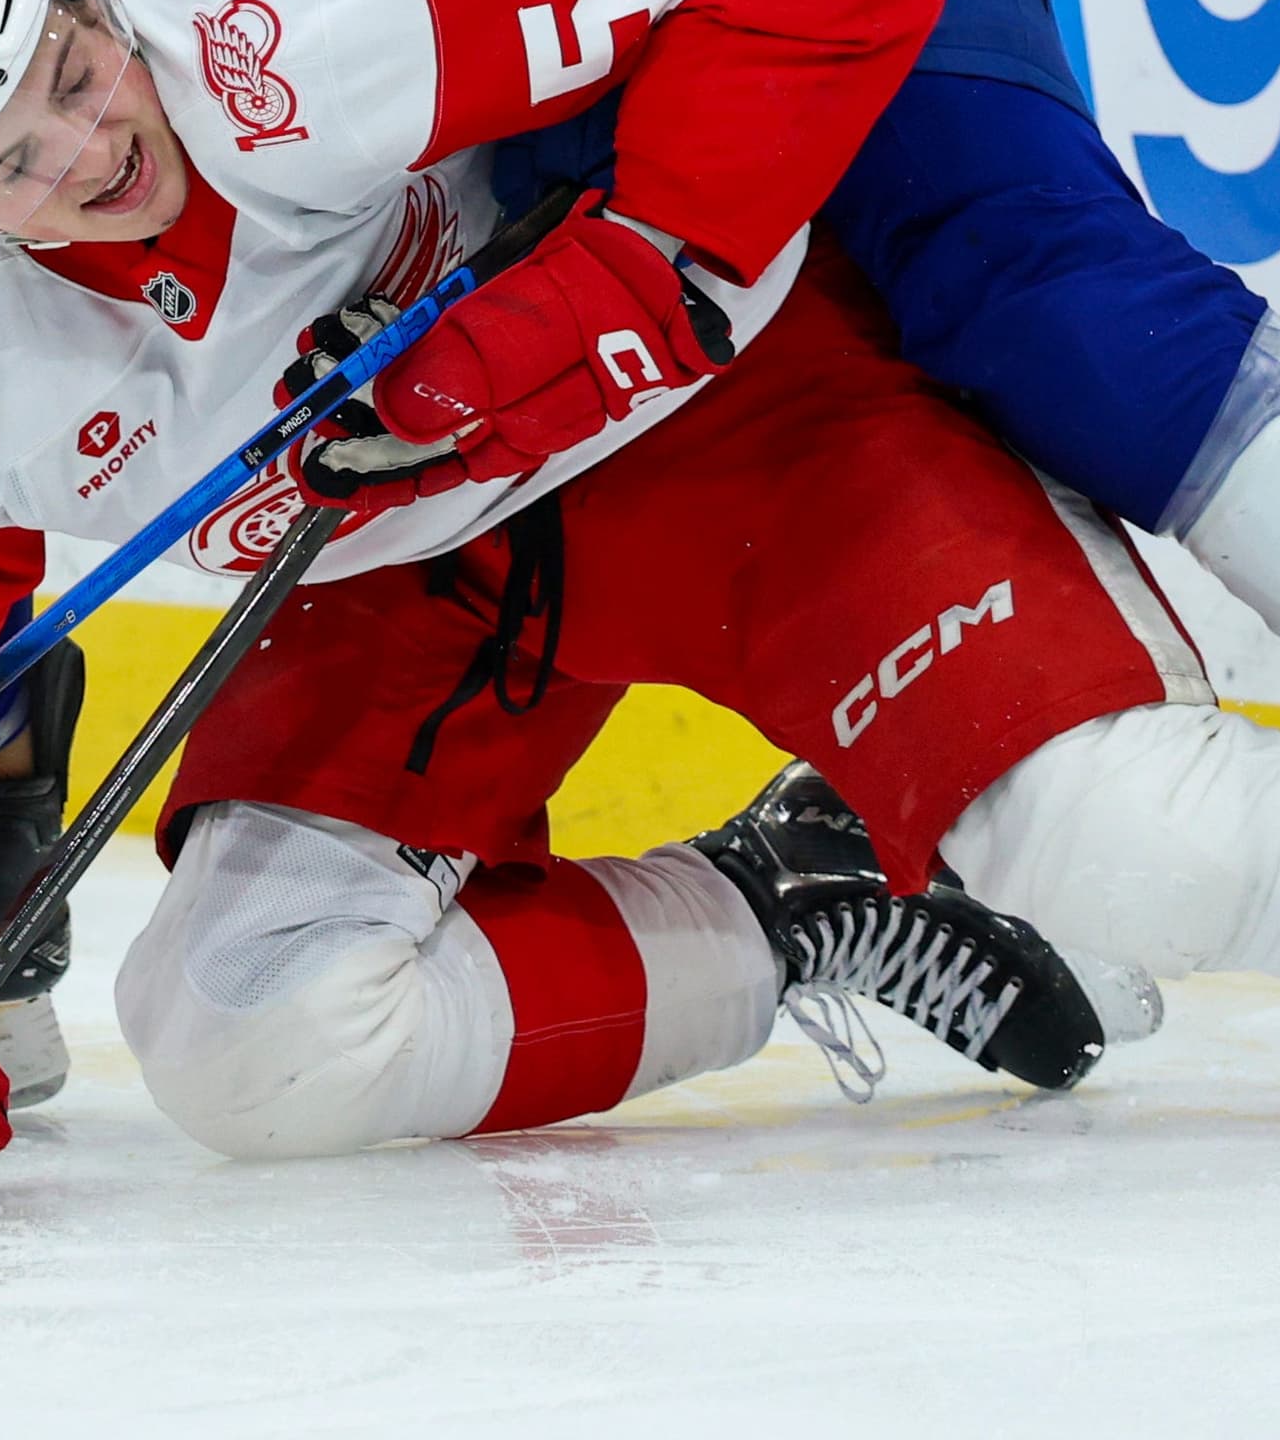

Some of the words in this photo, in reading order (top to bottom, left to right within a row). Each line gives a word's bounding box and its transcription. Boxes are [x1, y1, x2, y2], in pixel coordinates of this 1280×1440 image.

[165, 284, 176, 316] NHL
[413, 382, 475, 416] CCM
[277, 406, 312, 438] CERNAK
[77, 419, 157, 499] PRIORITY
[831, 578, 1015, 749] CCM
